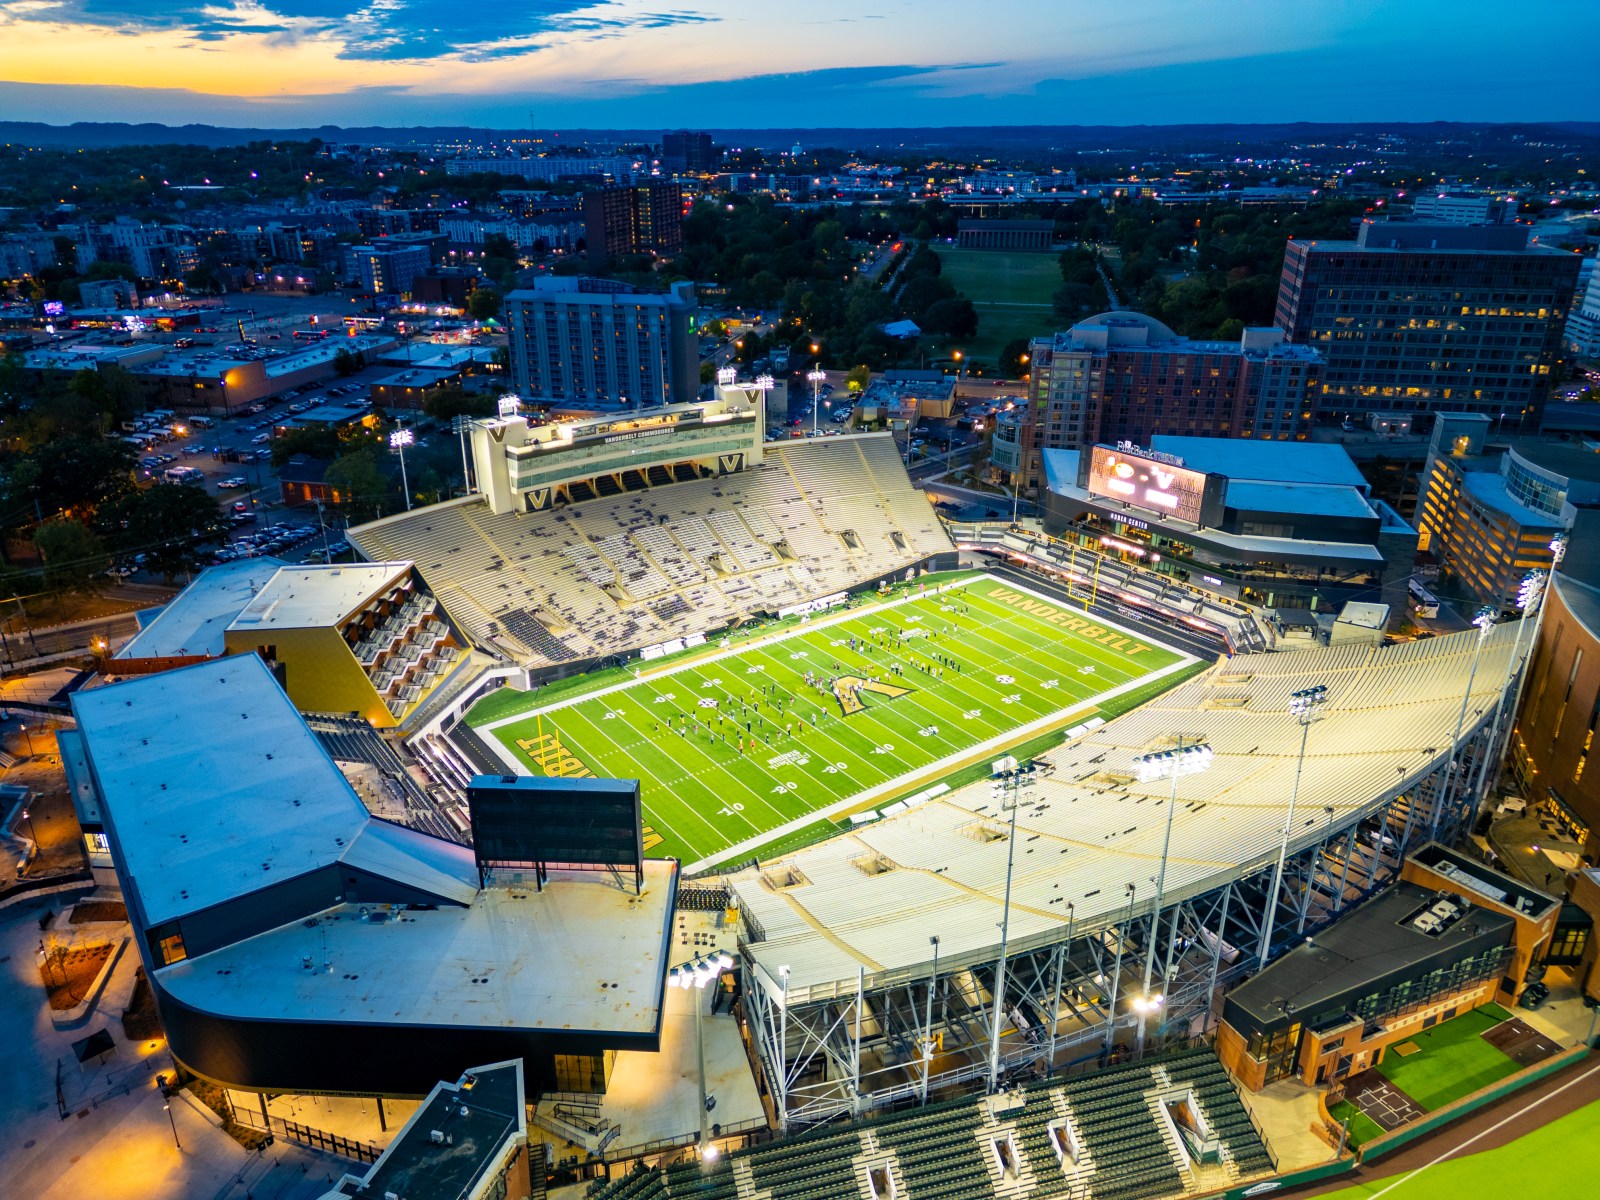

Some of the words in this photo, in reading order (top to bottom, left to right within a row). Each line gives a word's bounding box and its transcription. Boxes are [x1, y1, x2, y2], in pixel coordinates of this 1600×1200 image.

[744, 389, 760, 404] V
[488, 426, 506, 443] V
[604, 434, 637, 444] VANDERBILT
[637, 427, 675, 438] COMMODORES
[719, 455, 741, 472] V
[528, 489, 549, 510] V
[987, 587, 1153, 656] VANDERBILT
[826, 761, 848, 774] 30
[775, 781, 798, 795] 20
[720, 802, 745, 817] 10
